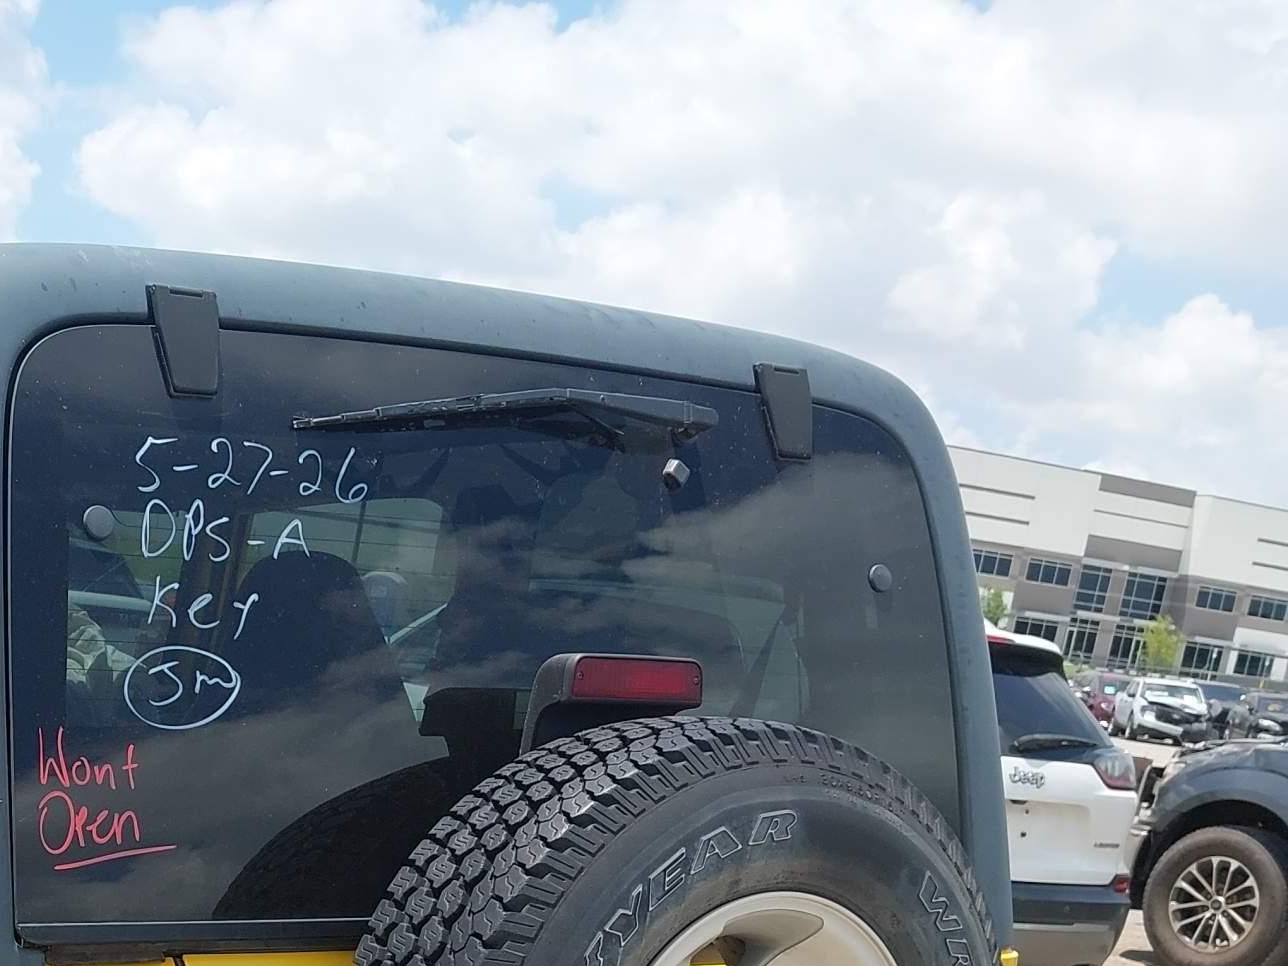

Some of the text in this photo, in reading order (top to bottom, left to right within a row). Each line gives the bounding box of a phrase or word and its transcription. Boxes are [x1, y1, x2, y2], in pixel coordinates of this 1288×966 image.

[135, 437, 368, 503] 5-27-26
[38, 726, 140, 791] Wont
[1009, 766, 1046, 789] Jeep
